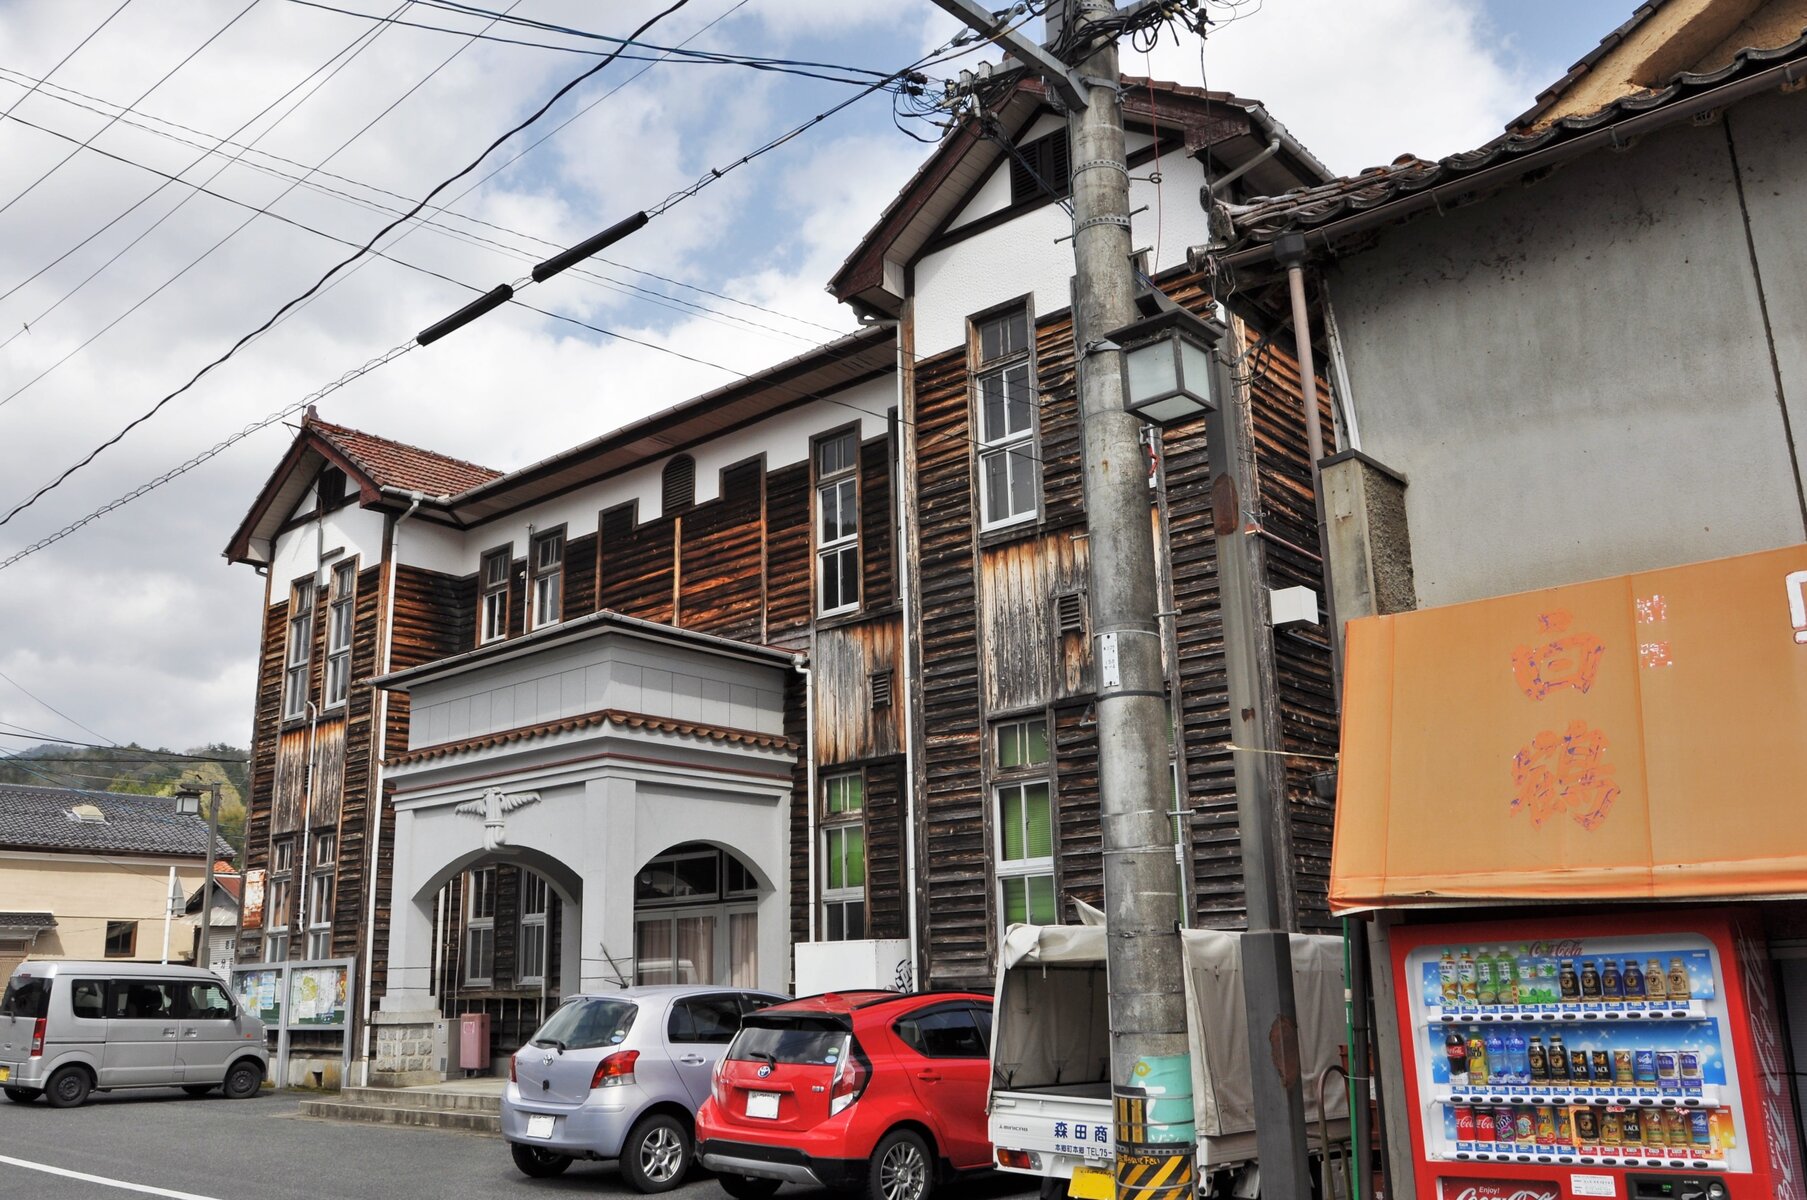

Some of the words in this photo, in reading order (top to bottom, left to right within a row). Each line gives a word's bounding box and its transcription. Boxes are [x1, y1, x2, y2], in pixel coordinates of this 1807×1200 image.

[1054, 1121, 1108, 1143] 森田商
[1086, 1146, 1099, 1156] TEL
[1479, 1186, 1500, 1194] Enjoy!
